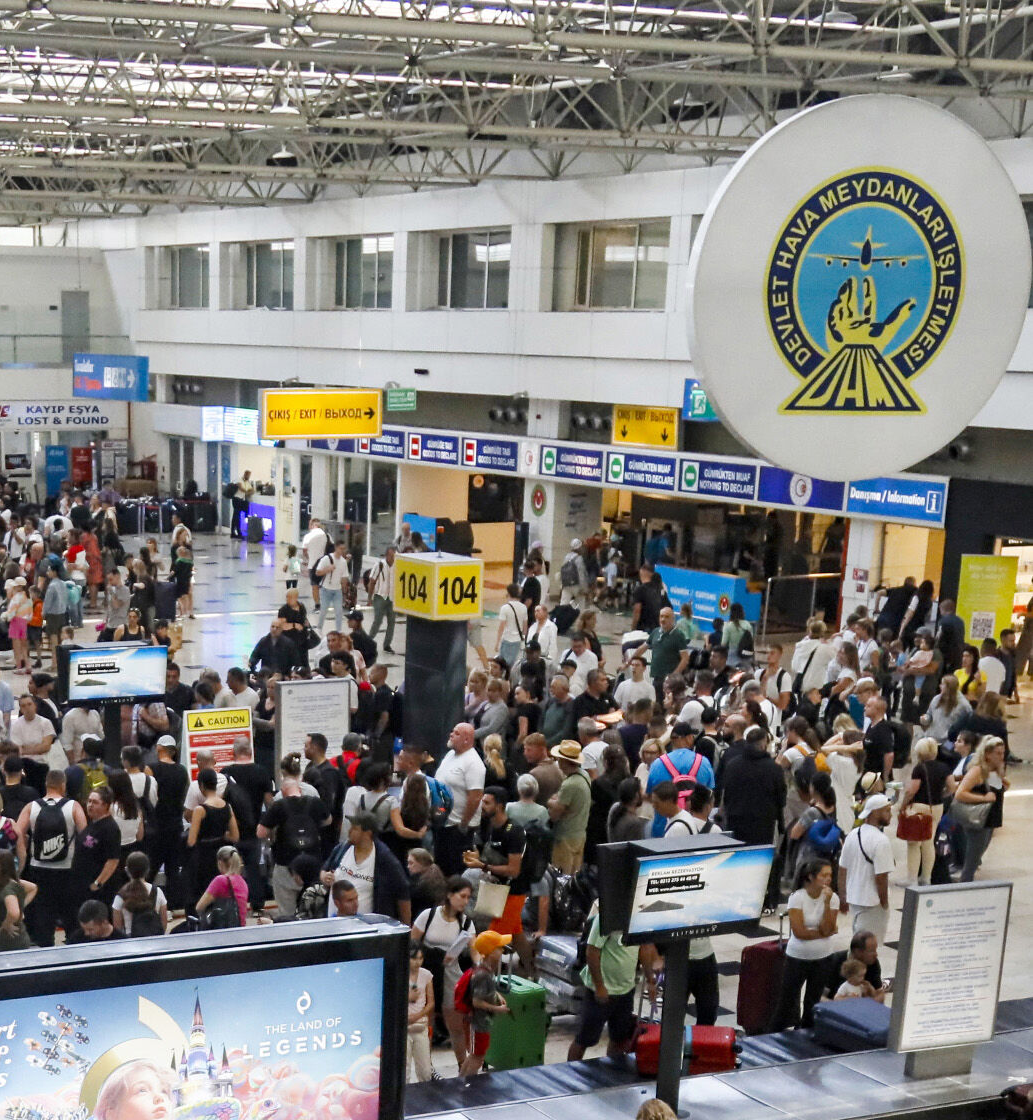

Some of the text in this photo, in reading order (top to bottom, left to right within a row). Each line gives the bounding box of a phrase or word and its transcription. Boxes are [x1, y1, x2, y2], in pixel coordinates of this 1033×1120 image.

[772, 177, 956, 372] DEVLET HAVA MEYDANLARI İŞLETMESİ
[26, 405, 100, 415] KAYIP EŞYA
[268, 409, 291, 422] ÇIKIŞ
[299, 409, 317, 419] EXIT
[325, 408, 362, 419] ВЫХОД
[17, 416, 49, 425] LOST
[53, 416, 62, 425] &
[66, 416, 109, 425] FOUND
[582, 466, 602, 477] DECLARE
[624, 472, 644, 482] NOTHING
[651, 475, 674, 486] DECLARE
[699, 480, 754, 495] NOTHING TO DECLARE
[850, 486, 881, 504] Danışma
[887, 490, 926, 507] Information
[399, 571, 428, 604] 104
[439, 575, 478, 605] 104
[207, 716, 245, 726] CAUTION
[43, 833, 65, 854] NIKE
[265, 1017, 342, 1035] THE LAND OF
[242, 1030, 362, 1060] LEGENDS
